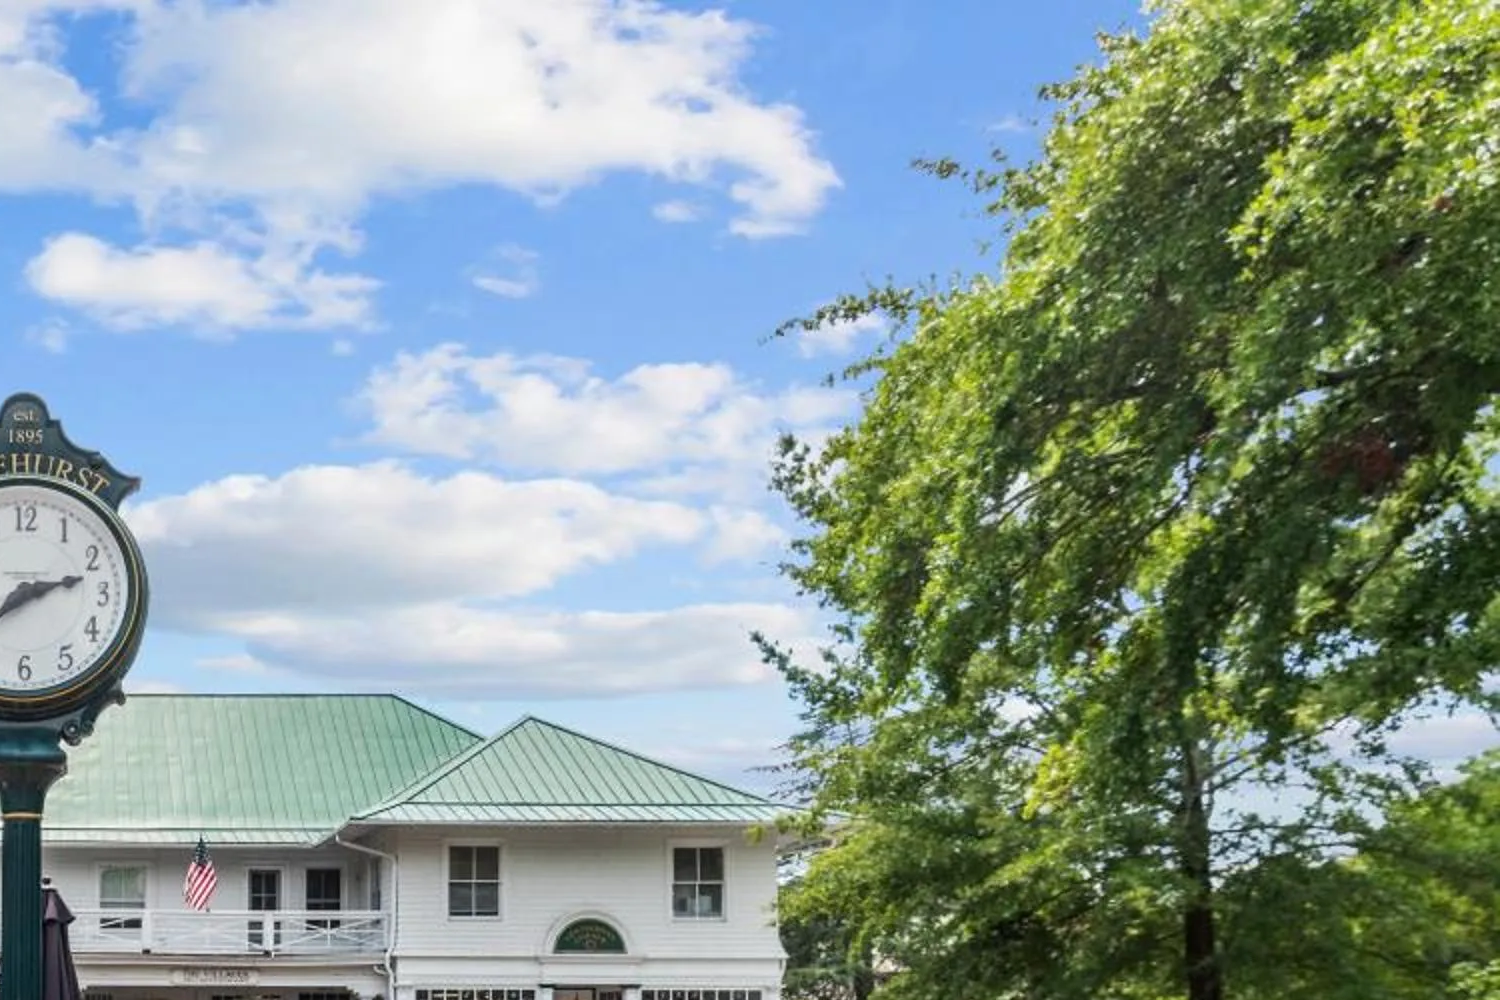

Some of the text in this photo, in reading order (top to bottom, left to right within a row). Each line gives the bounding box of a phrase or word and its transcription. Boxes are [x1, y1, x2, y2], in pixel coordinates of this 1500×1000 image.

[7, 429, 44, 444] 1895
[15, 507, 37, 531] 12
[60, 518, 69, 543] 1
[85, 546, 99, 571] 2
[97, 582, 109, 607] 3
[84, 616, 100, 642] 4
[17, 655, 32, 681] 6
[57, 646, 74, 671] 5
